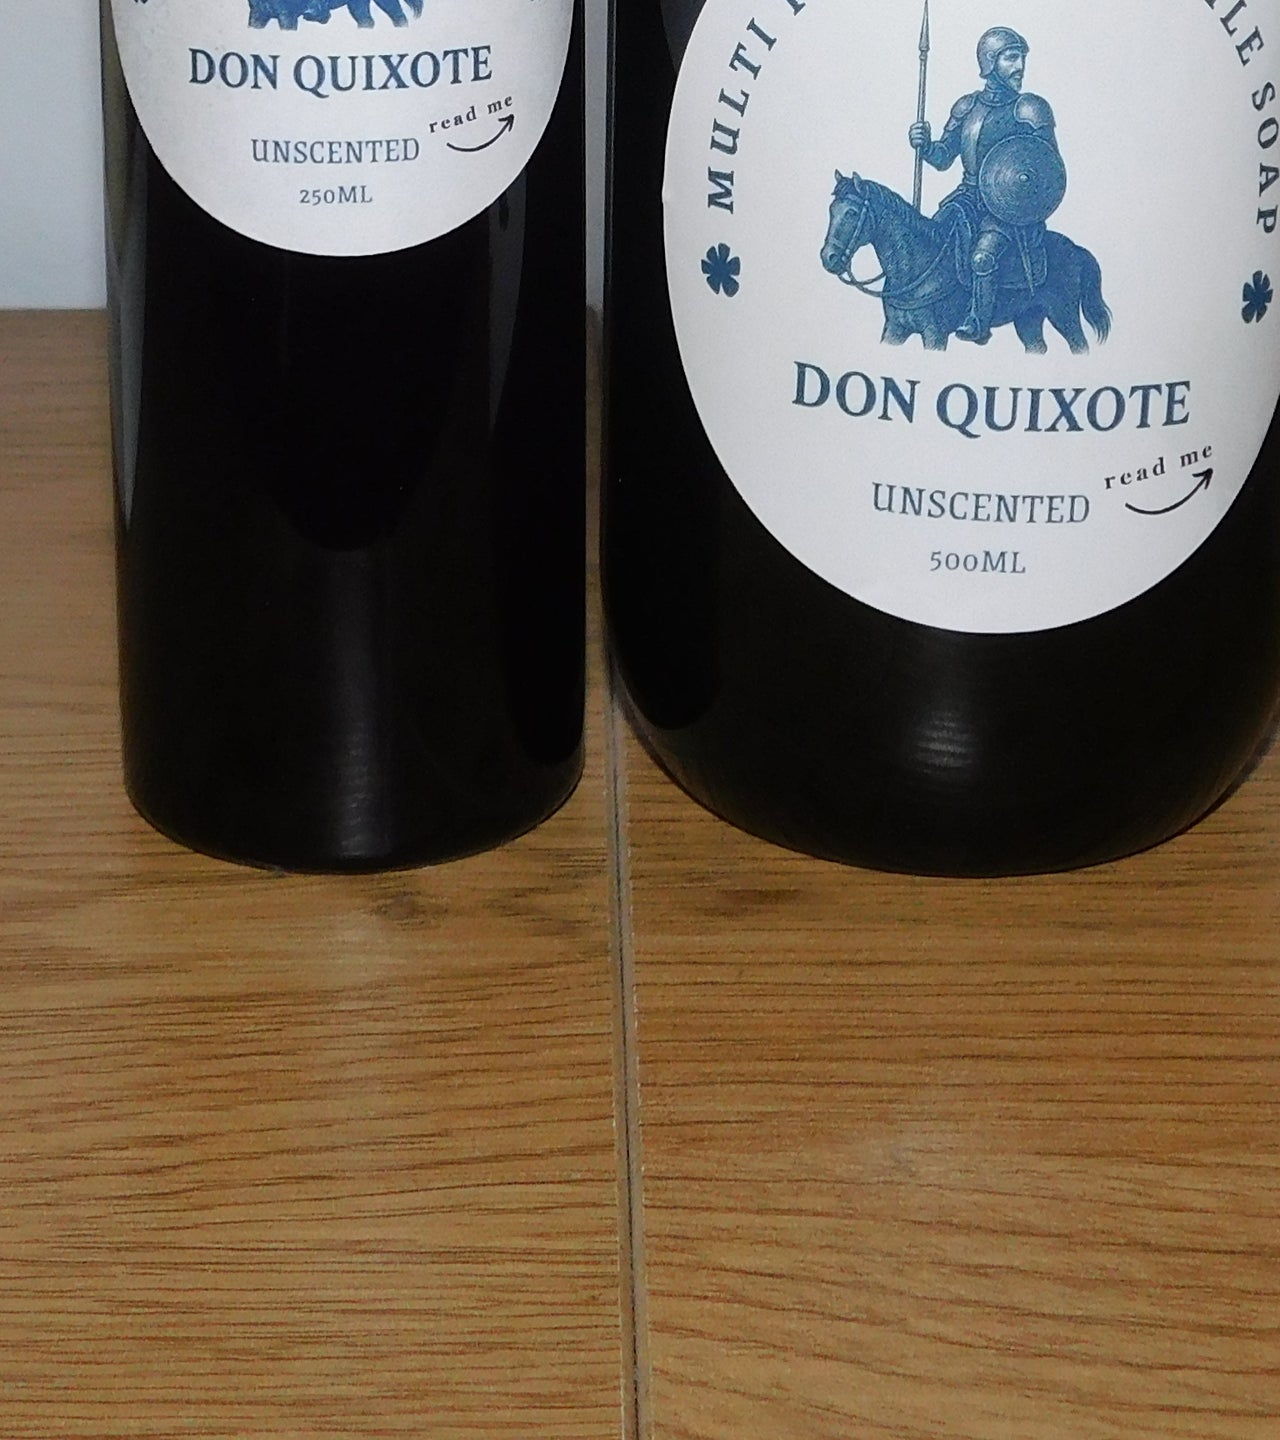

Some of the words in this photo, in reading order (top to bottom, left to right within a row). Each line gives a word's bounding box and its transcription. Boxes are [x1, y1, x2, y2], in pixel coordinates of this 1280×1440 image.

[188, 47, 280, 90] DON
[293, 44, 493, 99] QUIXOTE
[429, 105, 477, 134] read
[487, 96, 513, 115] me
[707, 17, 778, 215] MULTI
[1251, 81, 1280, 234] SOAP
[250, 137, 420, 165] UNSCENTED
[299, 184, 373, 207] 250ML
[791, 360, 921, 424] DON
[936, 380, 1191, 439] QUIXOTE
[1104, 456, 1166, 490] read
[1179, 446, 1212, 468] me
[871, 481, 1090, 524] UNSCENTED
[930, 550, 1026, 574] 500ML
